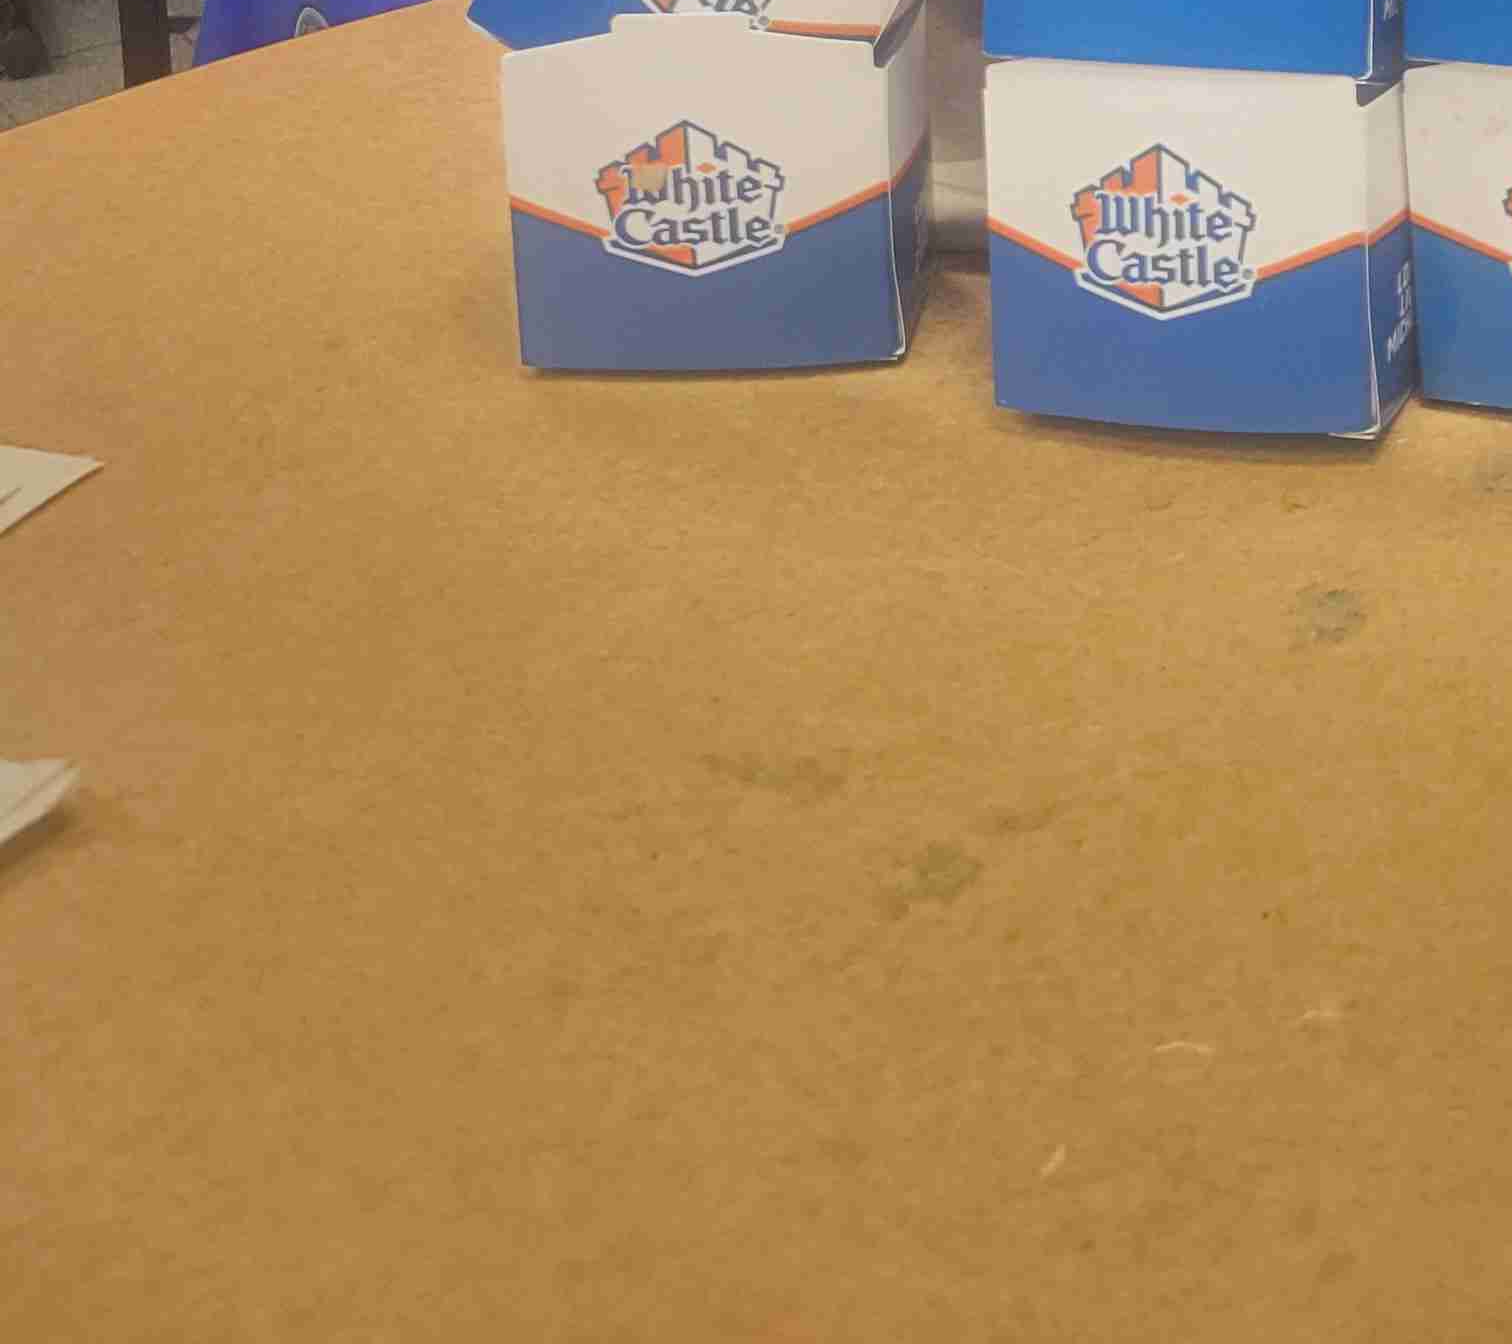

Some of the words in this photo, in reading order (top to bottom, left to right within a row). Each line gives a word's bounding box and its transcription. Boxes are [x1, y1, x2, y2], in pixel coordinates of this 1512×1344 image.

[615, 209, 770, 246] Castle
[1095, 193, 1233, 247] White
[1087, 240, 1240, 288] Castle
